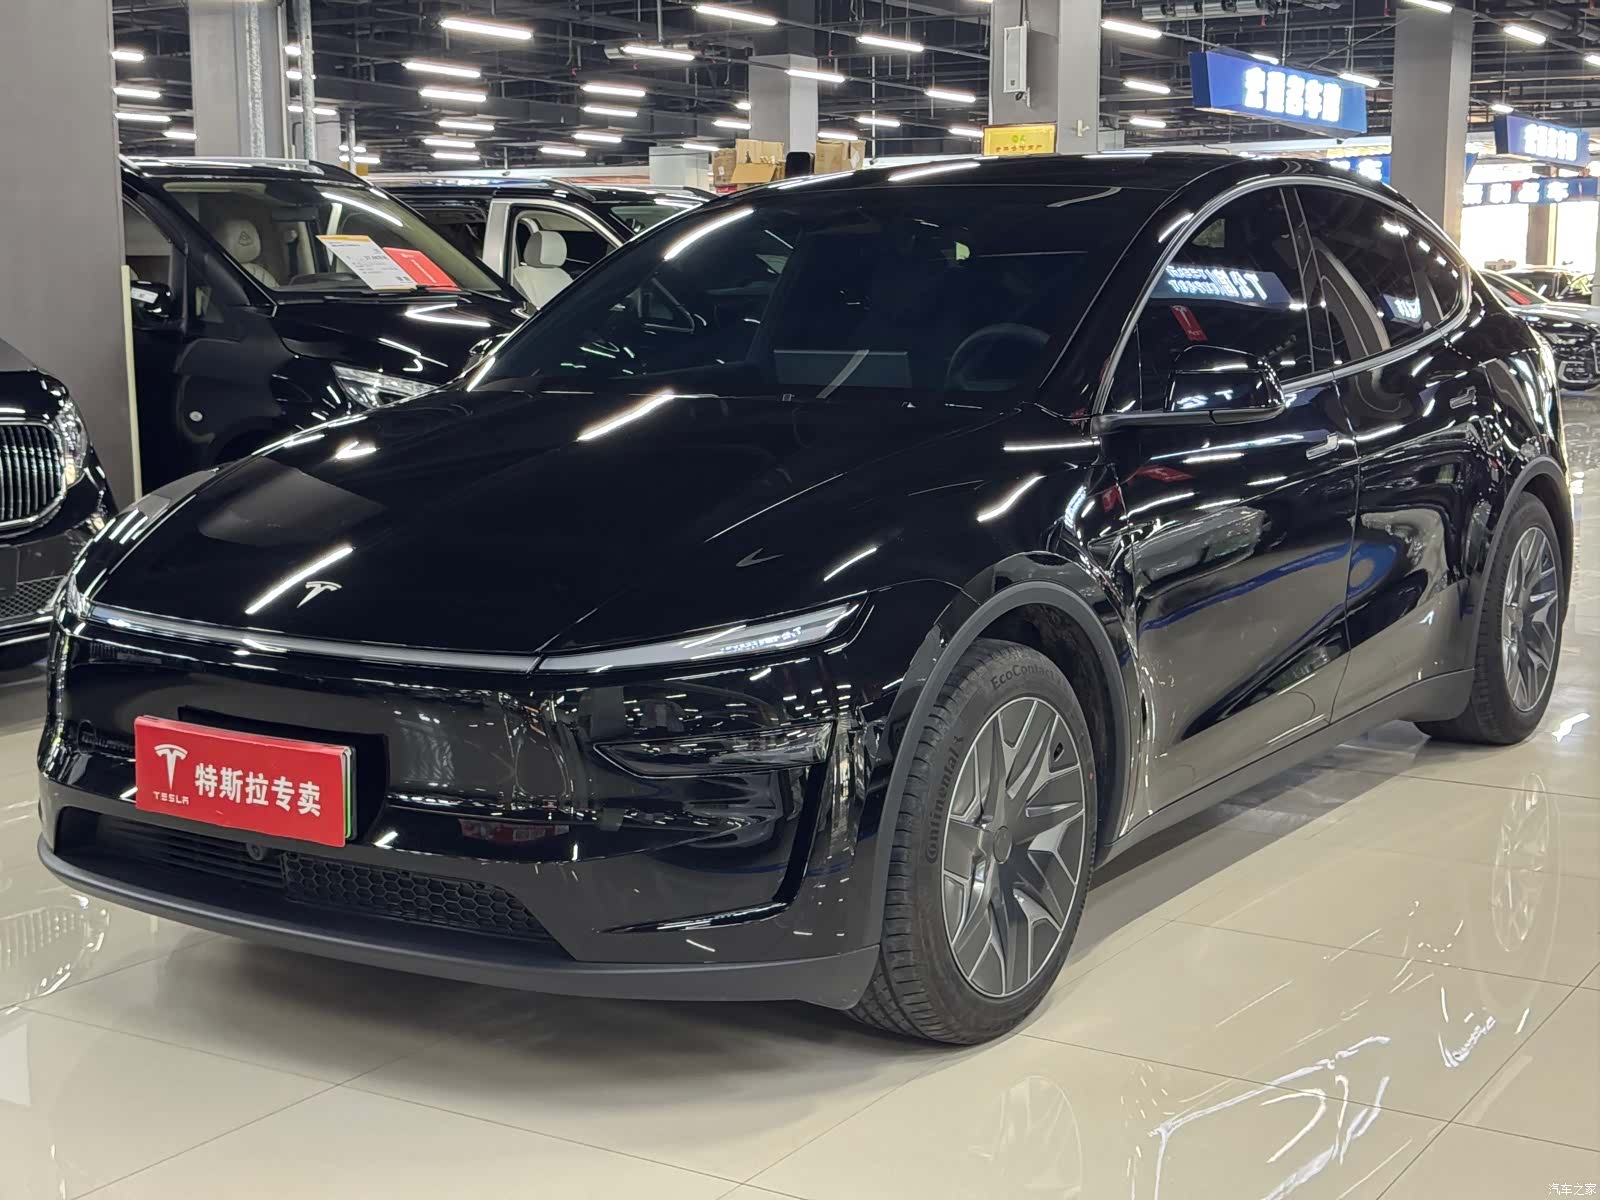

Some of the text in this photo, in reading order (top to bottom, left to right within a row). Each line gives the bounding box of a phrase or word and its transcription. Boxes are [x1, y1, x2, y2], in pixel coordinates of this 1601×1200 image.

[152, 790, 190, 805] TESLA
[195, 763, 321, 816] 特斯拉专卖
